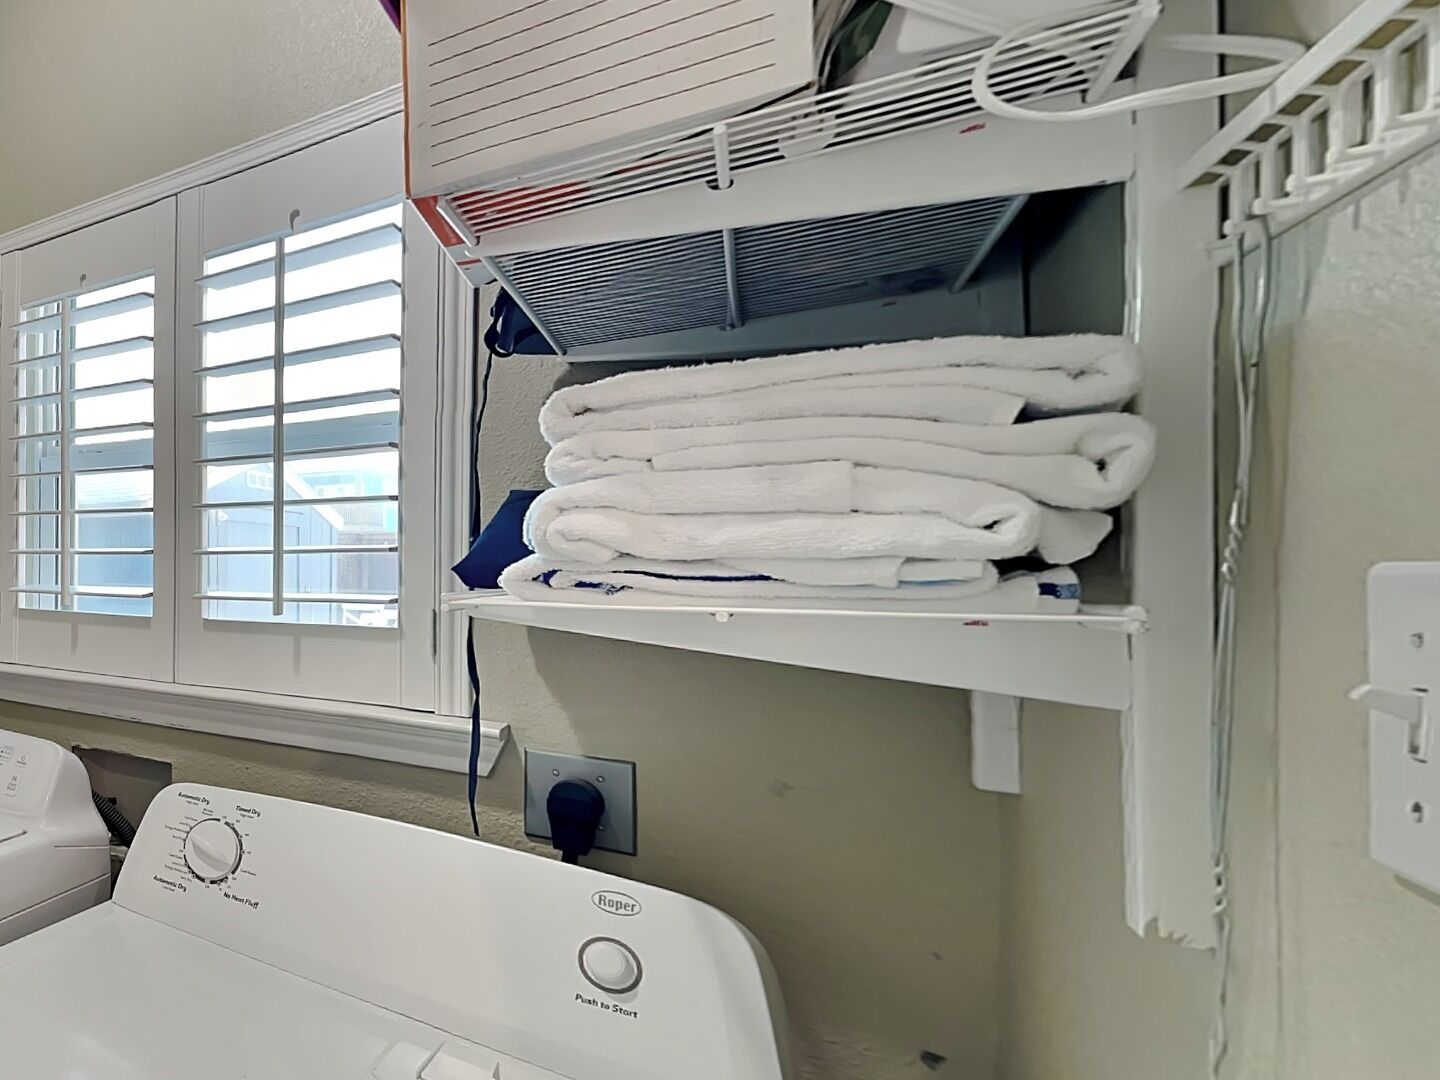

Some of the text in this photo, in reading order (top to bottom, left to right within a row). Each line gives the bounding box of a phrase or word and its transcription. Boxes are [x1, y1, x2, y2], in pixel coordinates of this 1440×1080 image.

[598, 894, 637, 912] Roper
[574, 993, 638, 1018] Push to Start
